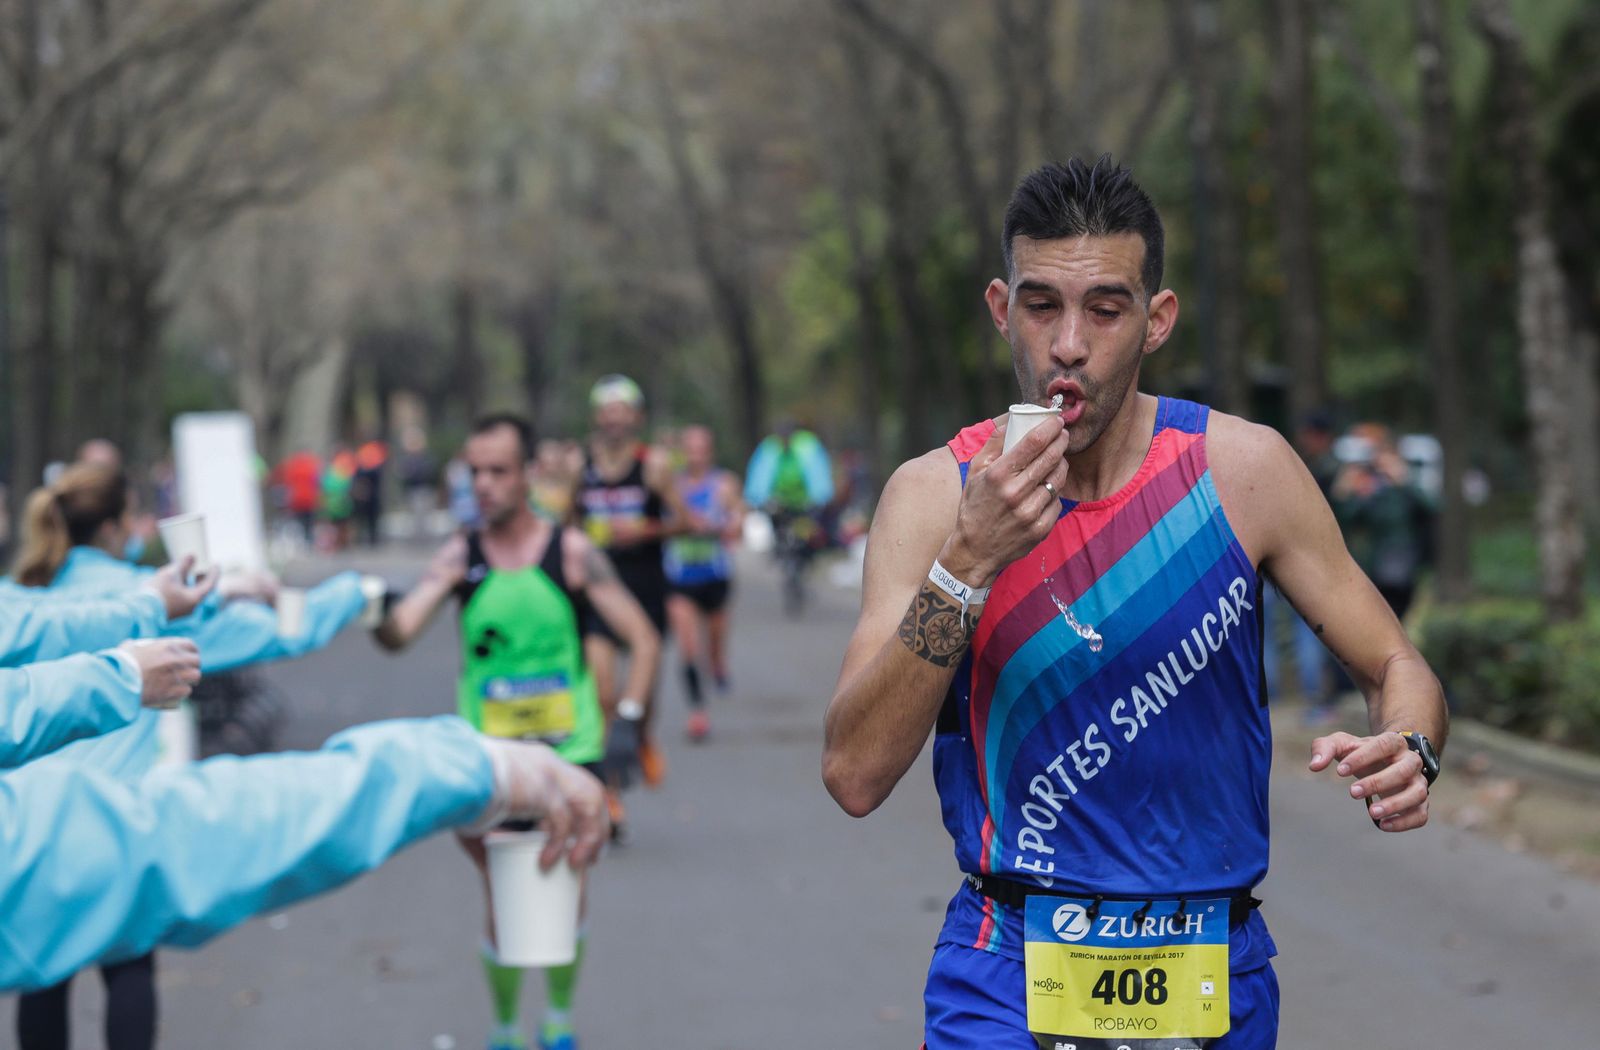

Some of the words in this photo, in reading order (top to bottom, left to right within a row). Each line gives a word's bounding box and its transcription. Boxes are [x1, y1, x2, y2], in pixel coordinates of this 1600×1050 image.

[1014, 722, 1111, 888] EPORTES
[1110, 576, 1253, 743] SANLUCAR
[1098, 914, 1204, 938] ZURICH
[1069, 952, 1095, 960] ZURICH
[1091, 968, 1168, 1005] 408
[1203, 1003, 1212, 1012] M
[1094, 1017, 1157, 1030] ROBAYO
